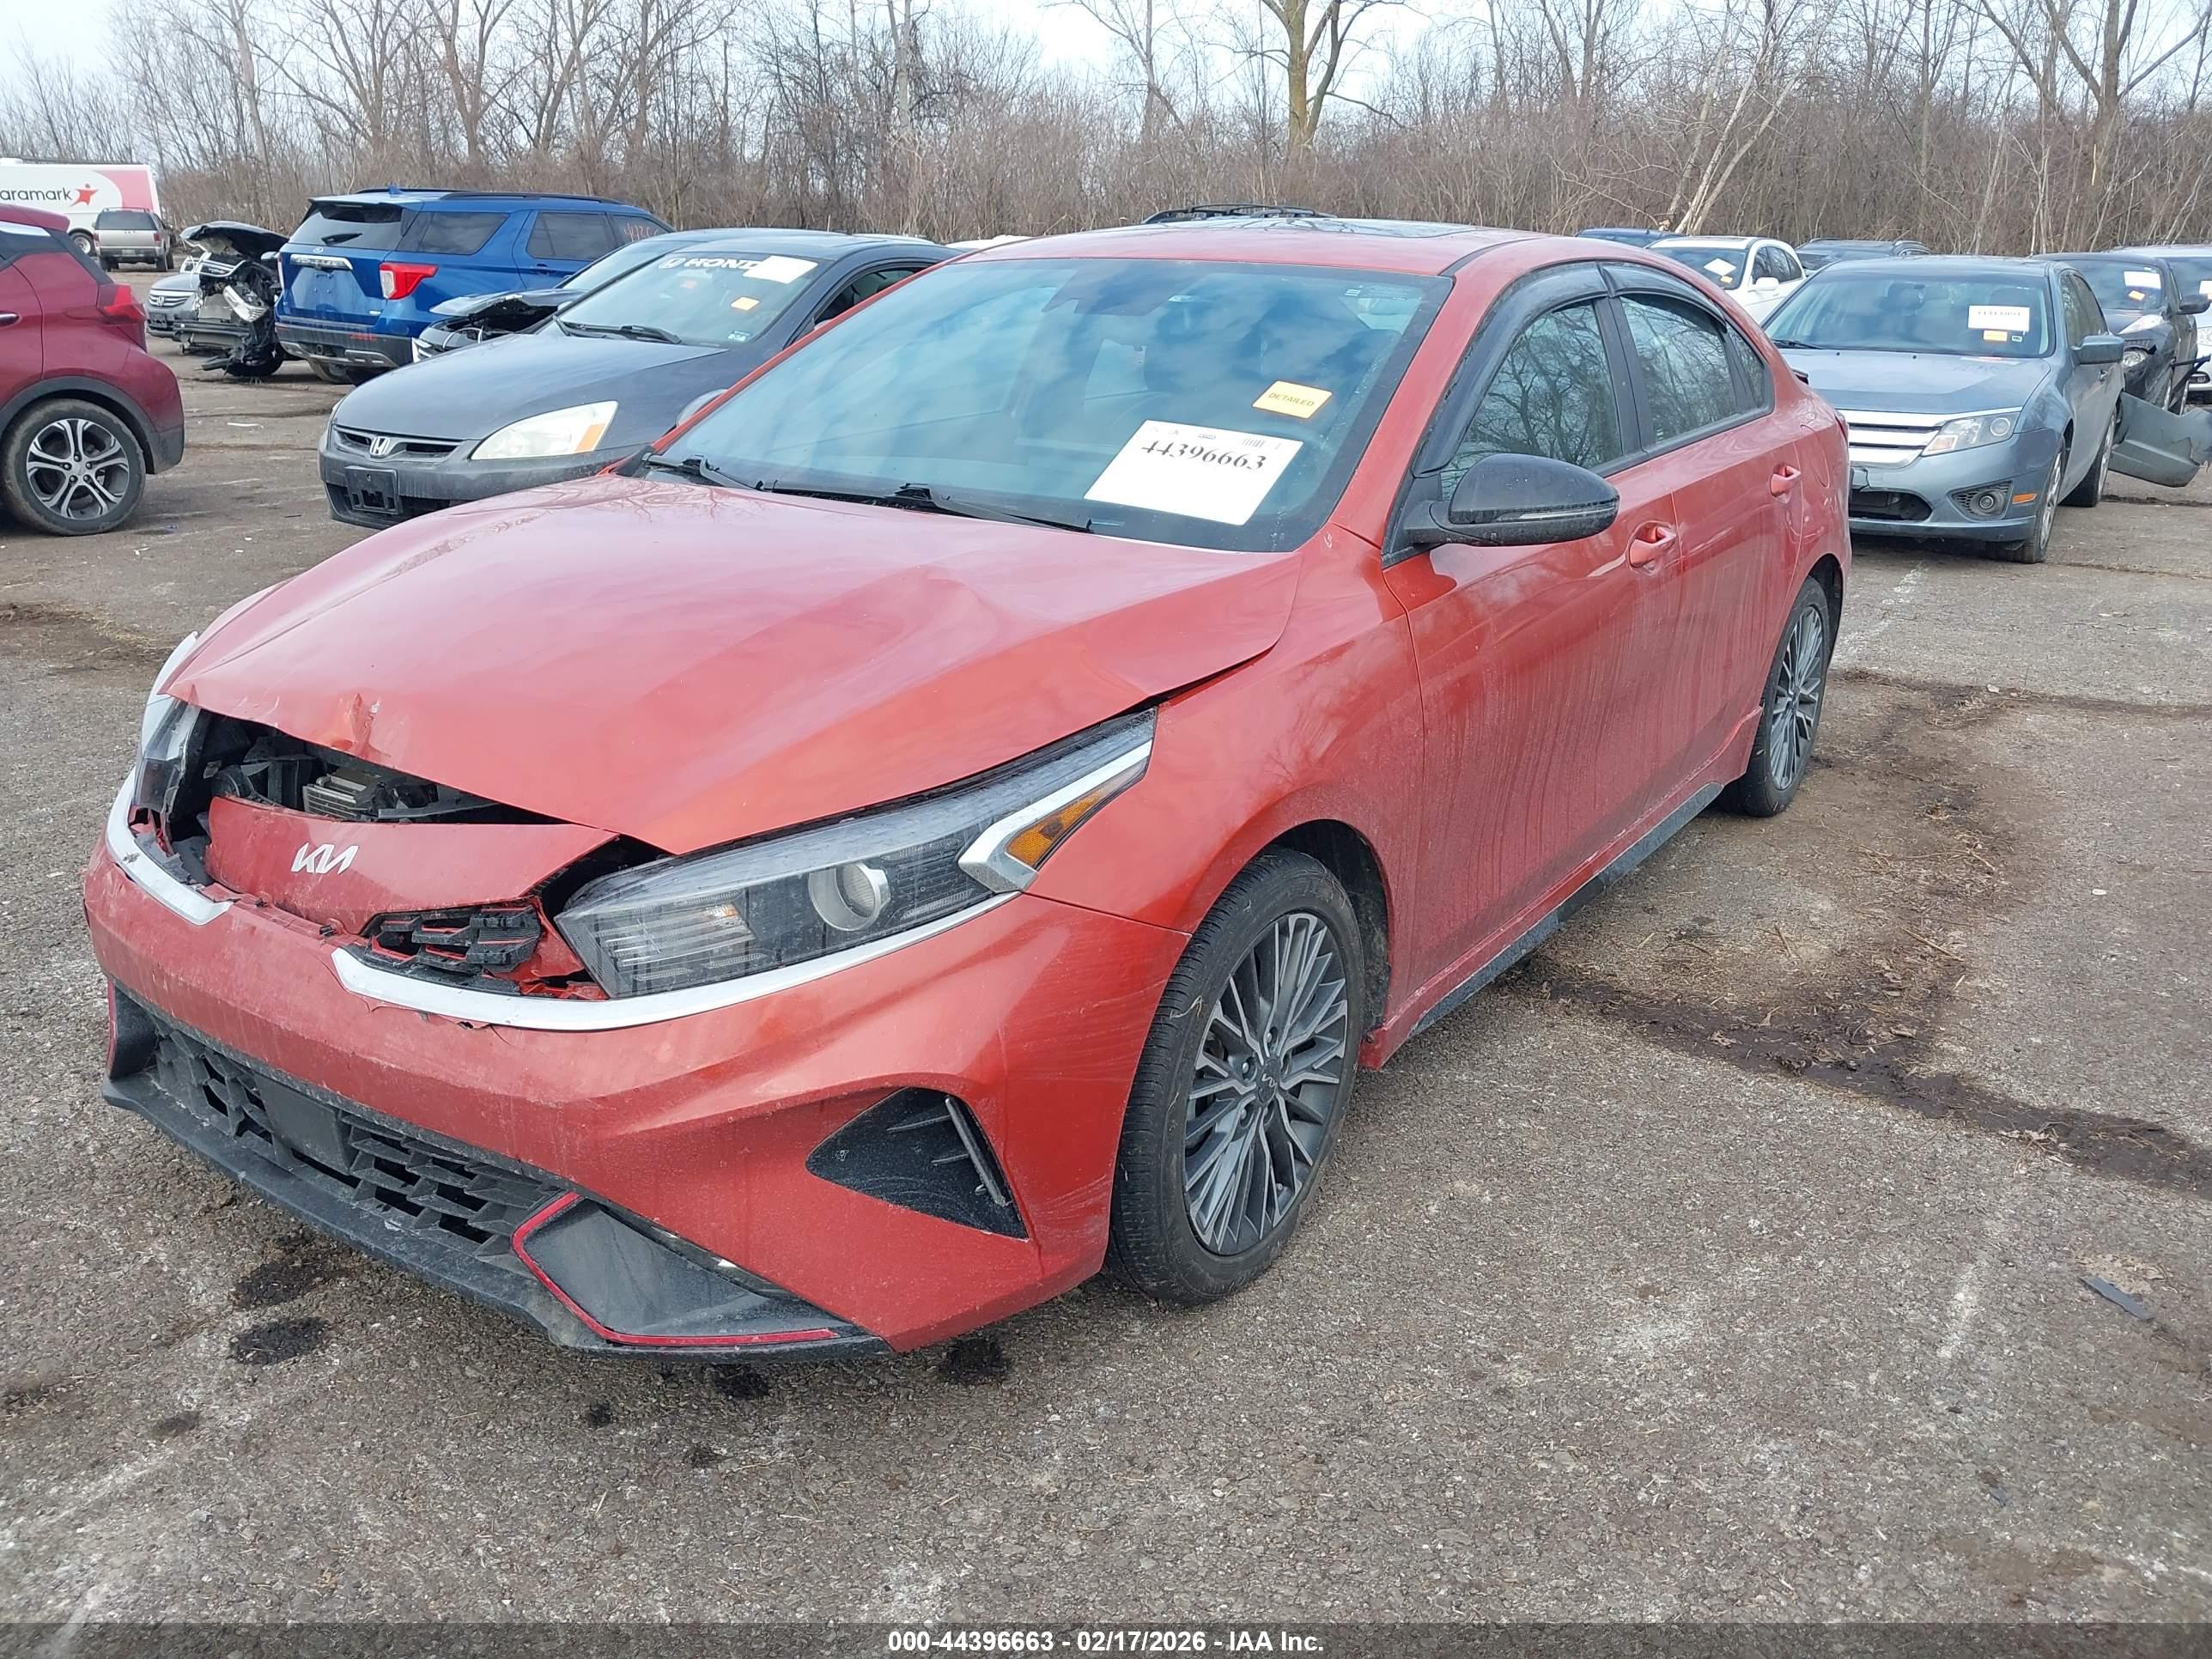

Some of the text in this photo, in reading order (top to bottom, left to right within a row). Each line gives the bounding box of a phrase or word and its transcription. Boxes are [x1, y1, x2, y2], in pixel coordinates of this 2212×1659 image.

[0, 187, 72, 201] aramark
[684, 258, 761, 270] HOND
[1268, 392, 1315, 407] DETAILED
[1141, 440, 1267, 470] 44396663
